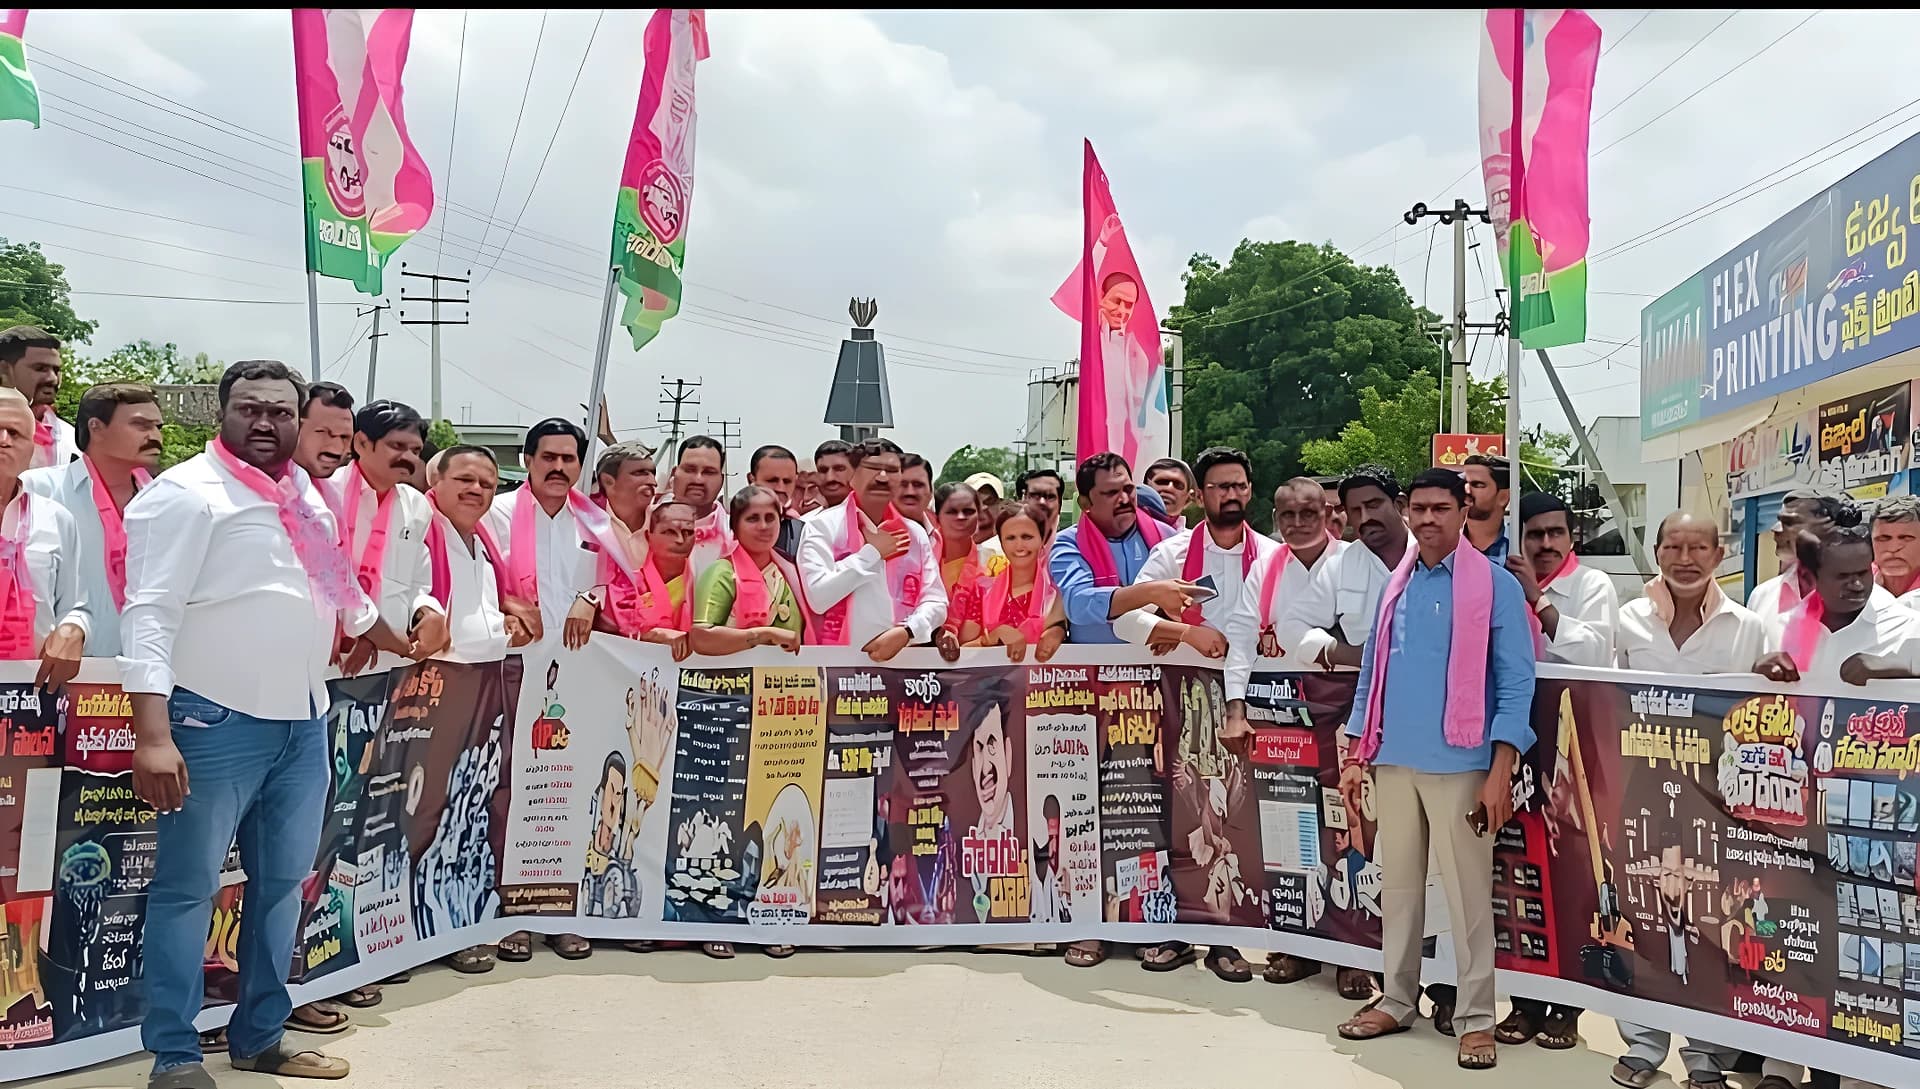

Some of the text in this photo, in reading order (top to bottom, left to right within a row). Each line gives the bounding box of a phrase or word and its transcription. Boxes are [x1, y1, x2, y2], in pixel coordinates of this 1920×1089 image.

[1712, 250, 1760, 330] FLEX
[1873, 270, 1920, 336] ప్రింటి
[1712, 292, 1838, 400] PRINTING
